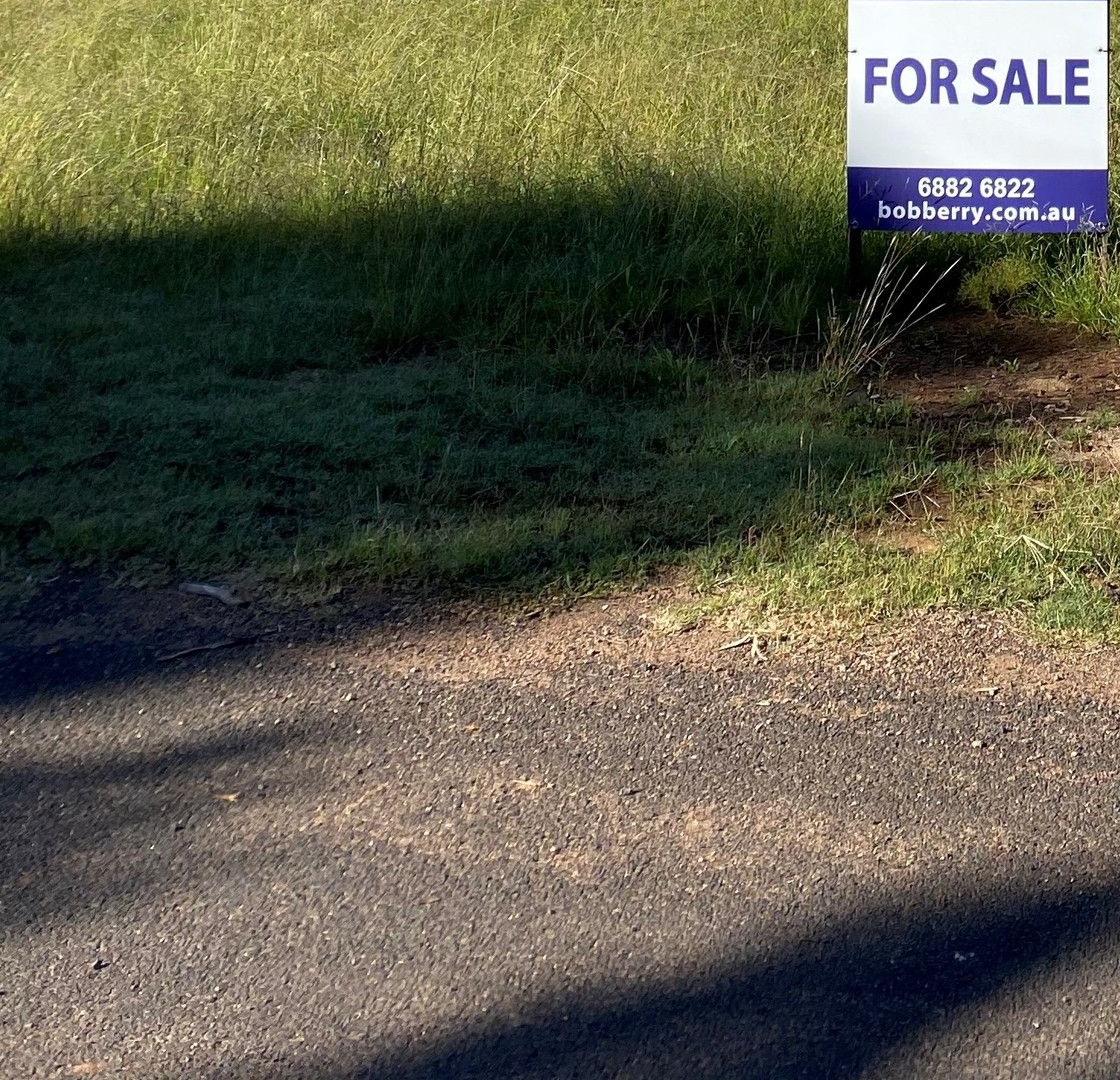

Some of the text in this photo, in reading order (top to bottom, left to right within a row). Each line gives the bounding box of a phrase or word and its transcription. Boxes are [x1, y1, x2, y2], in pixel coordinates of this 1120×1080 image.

[864, 58, 1090, 105] FOR SALE
[918, 177, 1035, 198] 6882 6822
[878, 201, 1075, 225] bobberry.com.au
